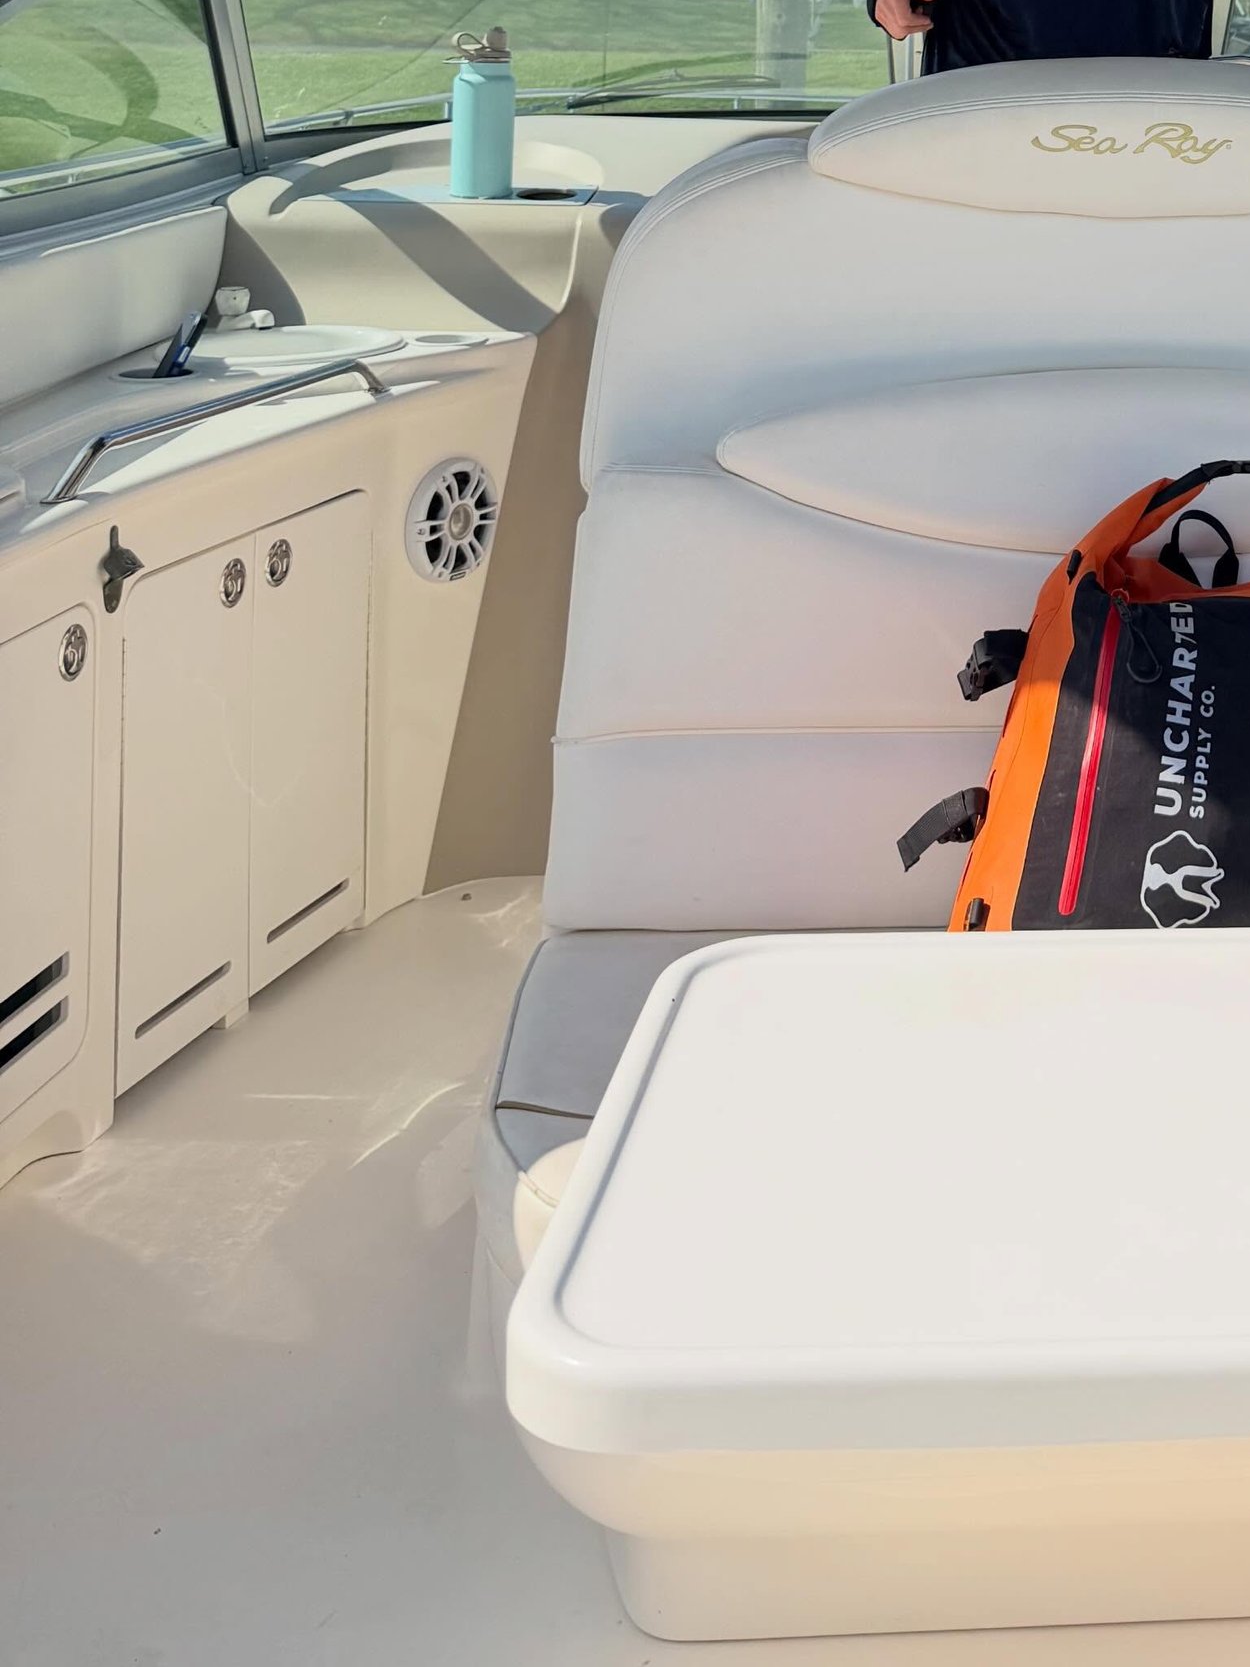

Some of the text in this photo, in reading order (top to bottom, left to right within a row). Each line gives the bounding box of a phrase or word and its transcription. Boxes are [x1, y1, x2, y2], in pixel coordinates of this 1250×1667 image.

[1031, 122, 1233, 165] Sea Ray
[1189, 685, 1216, 819] SUPPLY CO.
